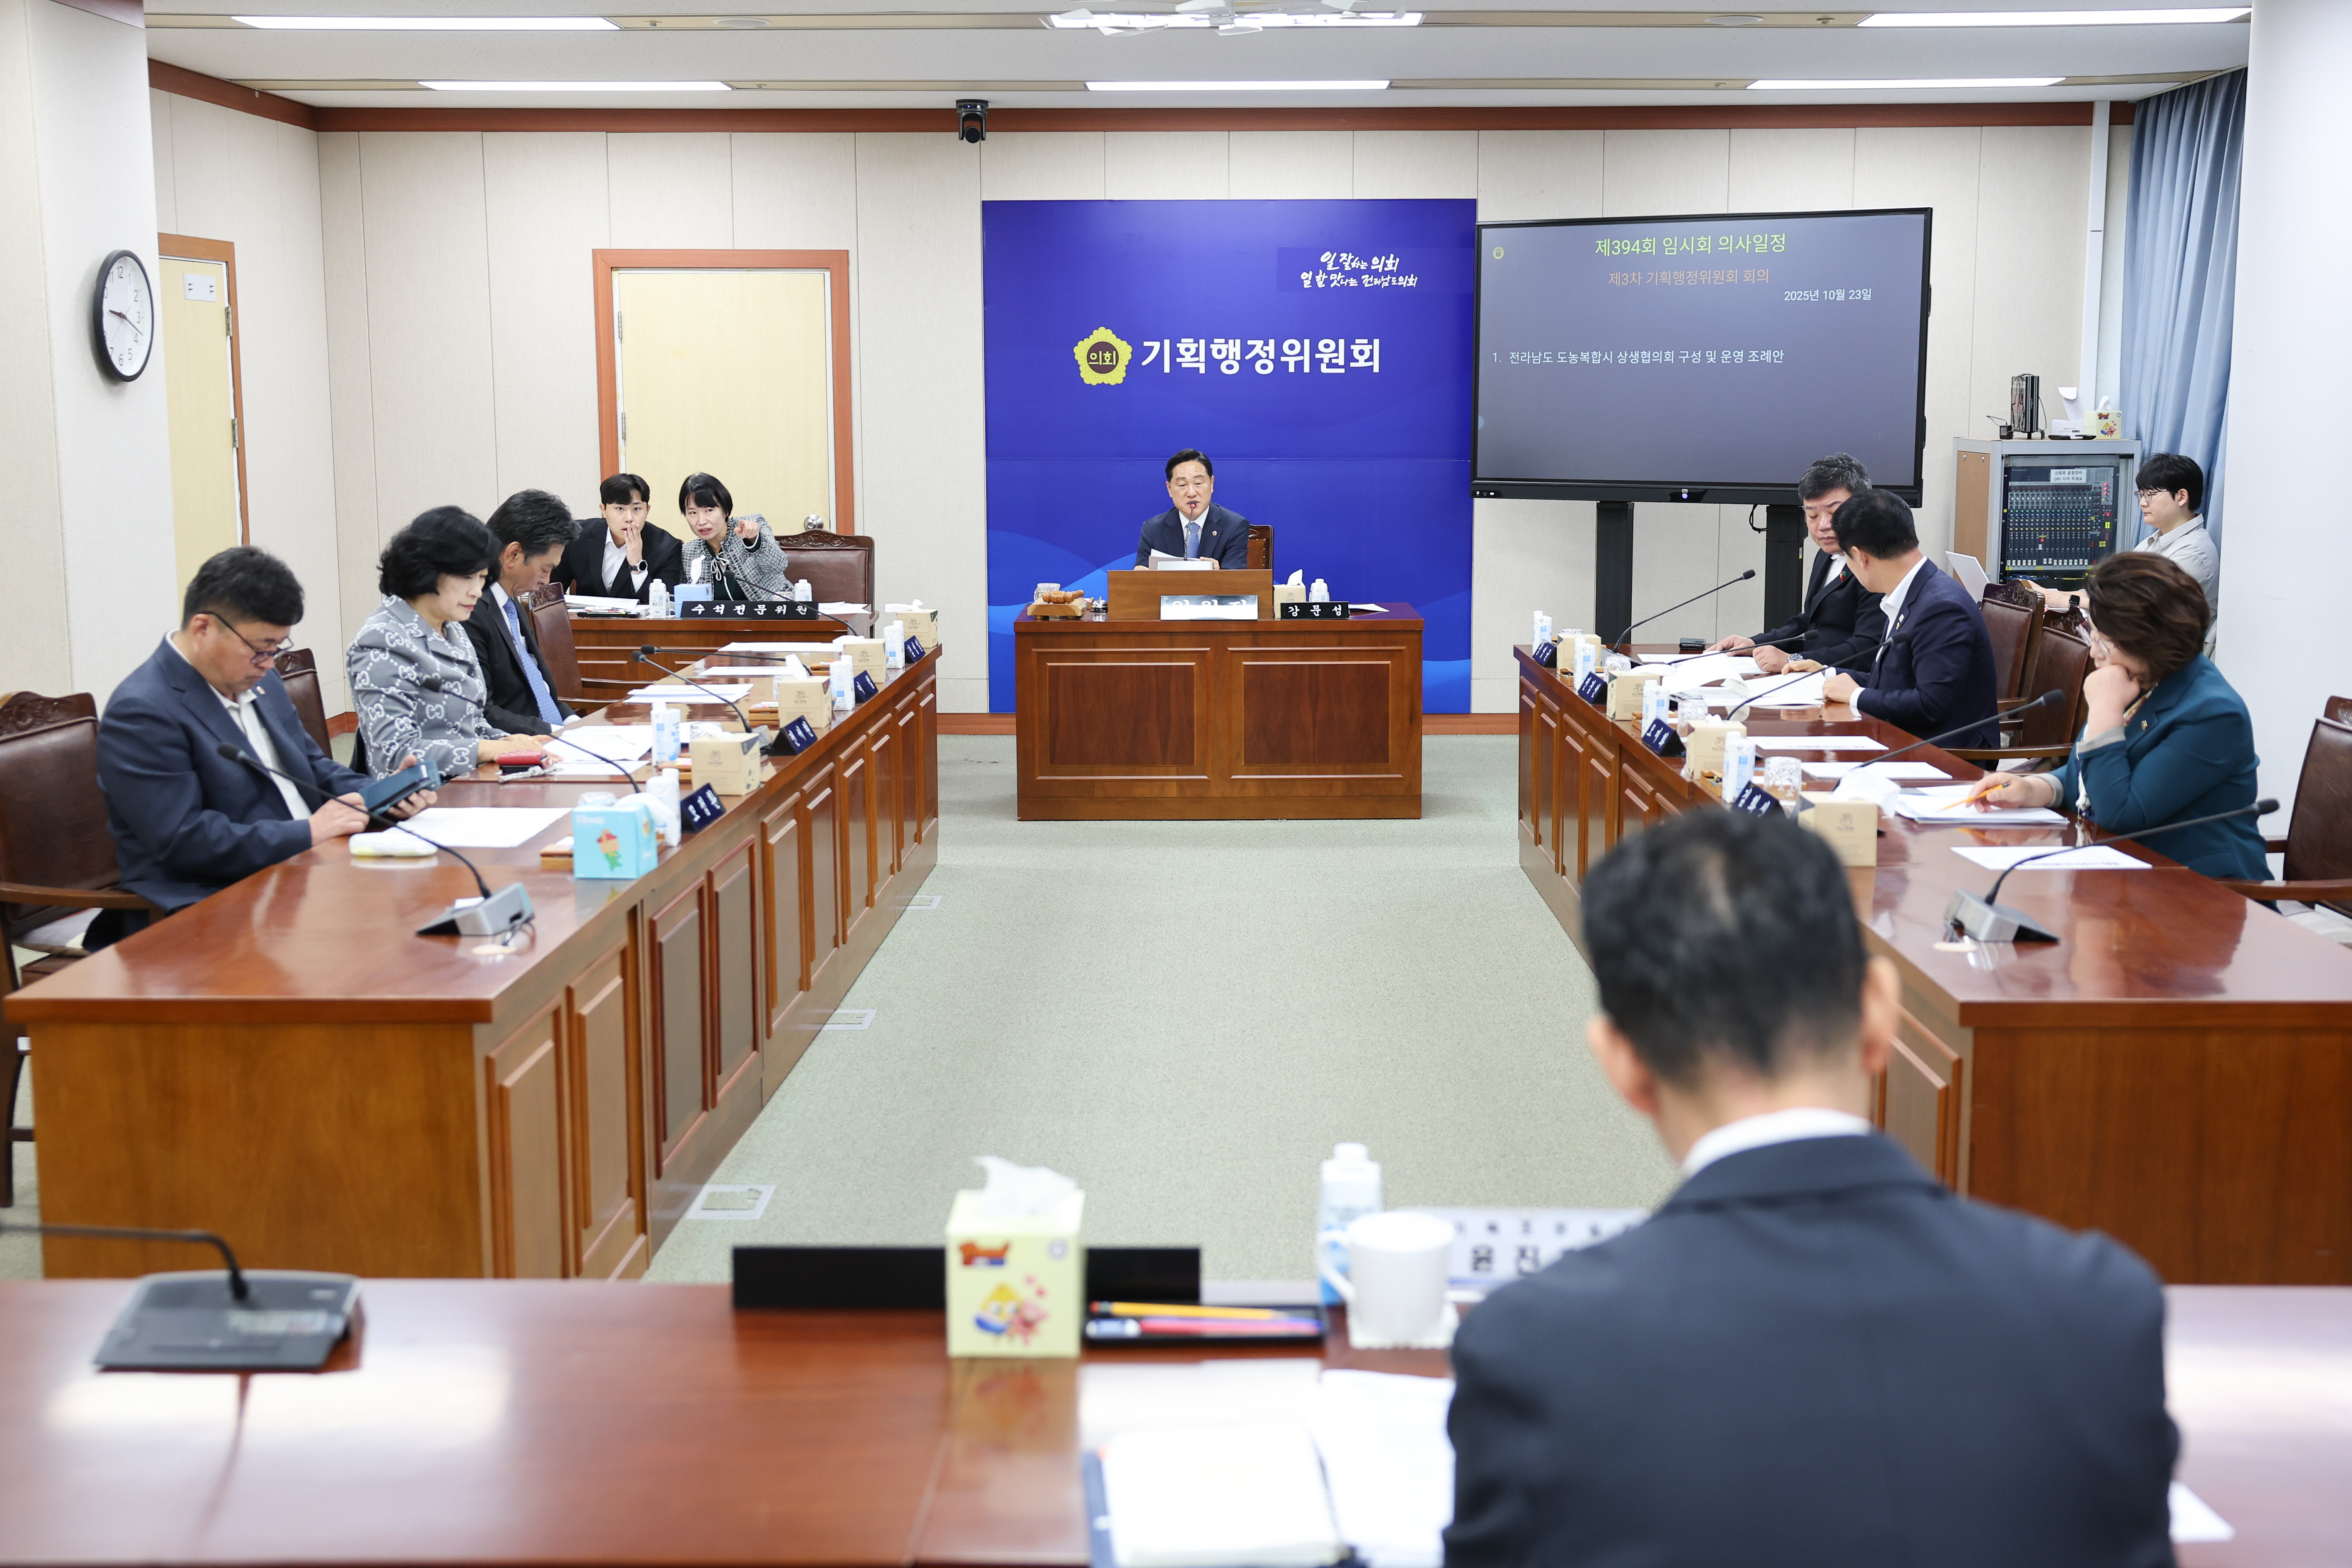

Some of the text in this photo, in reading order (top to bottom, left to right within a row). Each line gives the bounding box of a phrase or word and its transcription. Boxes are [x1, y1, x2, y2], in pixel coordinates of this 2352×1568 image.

[1595, 233, 1786, 256] 제394회 임시회 의사일정
[1320, 251, 1399, 273] 일 잘하는 의회
[117, 266, 123, 278] 12
[1609, 269, 1769, 286] 제3차 기획행정위원회 회의
[1300, 270, 1312, 288] 일
[1330, 272, 1358, 288] 맛나는
[1362, 274, 1418, 288] 전라남도의회
[134, 290, 138, 302] 2
[1784, 288, 1871, 300] 2025년 10월 23일
[137, 312, 141, 323] 3
[134, 332, 139, 345] 4
[110, 347, 114, 357] 7
[128, 348, 132, 360] 5
[1089, 338, 1379, 374] 의회 기획행정위원회
[1493, 350, 1784, 364] 1. 전라남도 도농복합시 상생협의회 구성 및 운영 조례안
[119, 354, 123, 366] 6
[691, 604, 807, 615] 수석전문위원
[1288, 605, 1342, 617] 강문성
